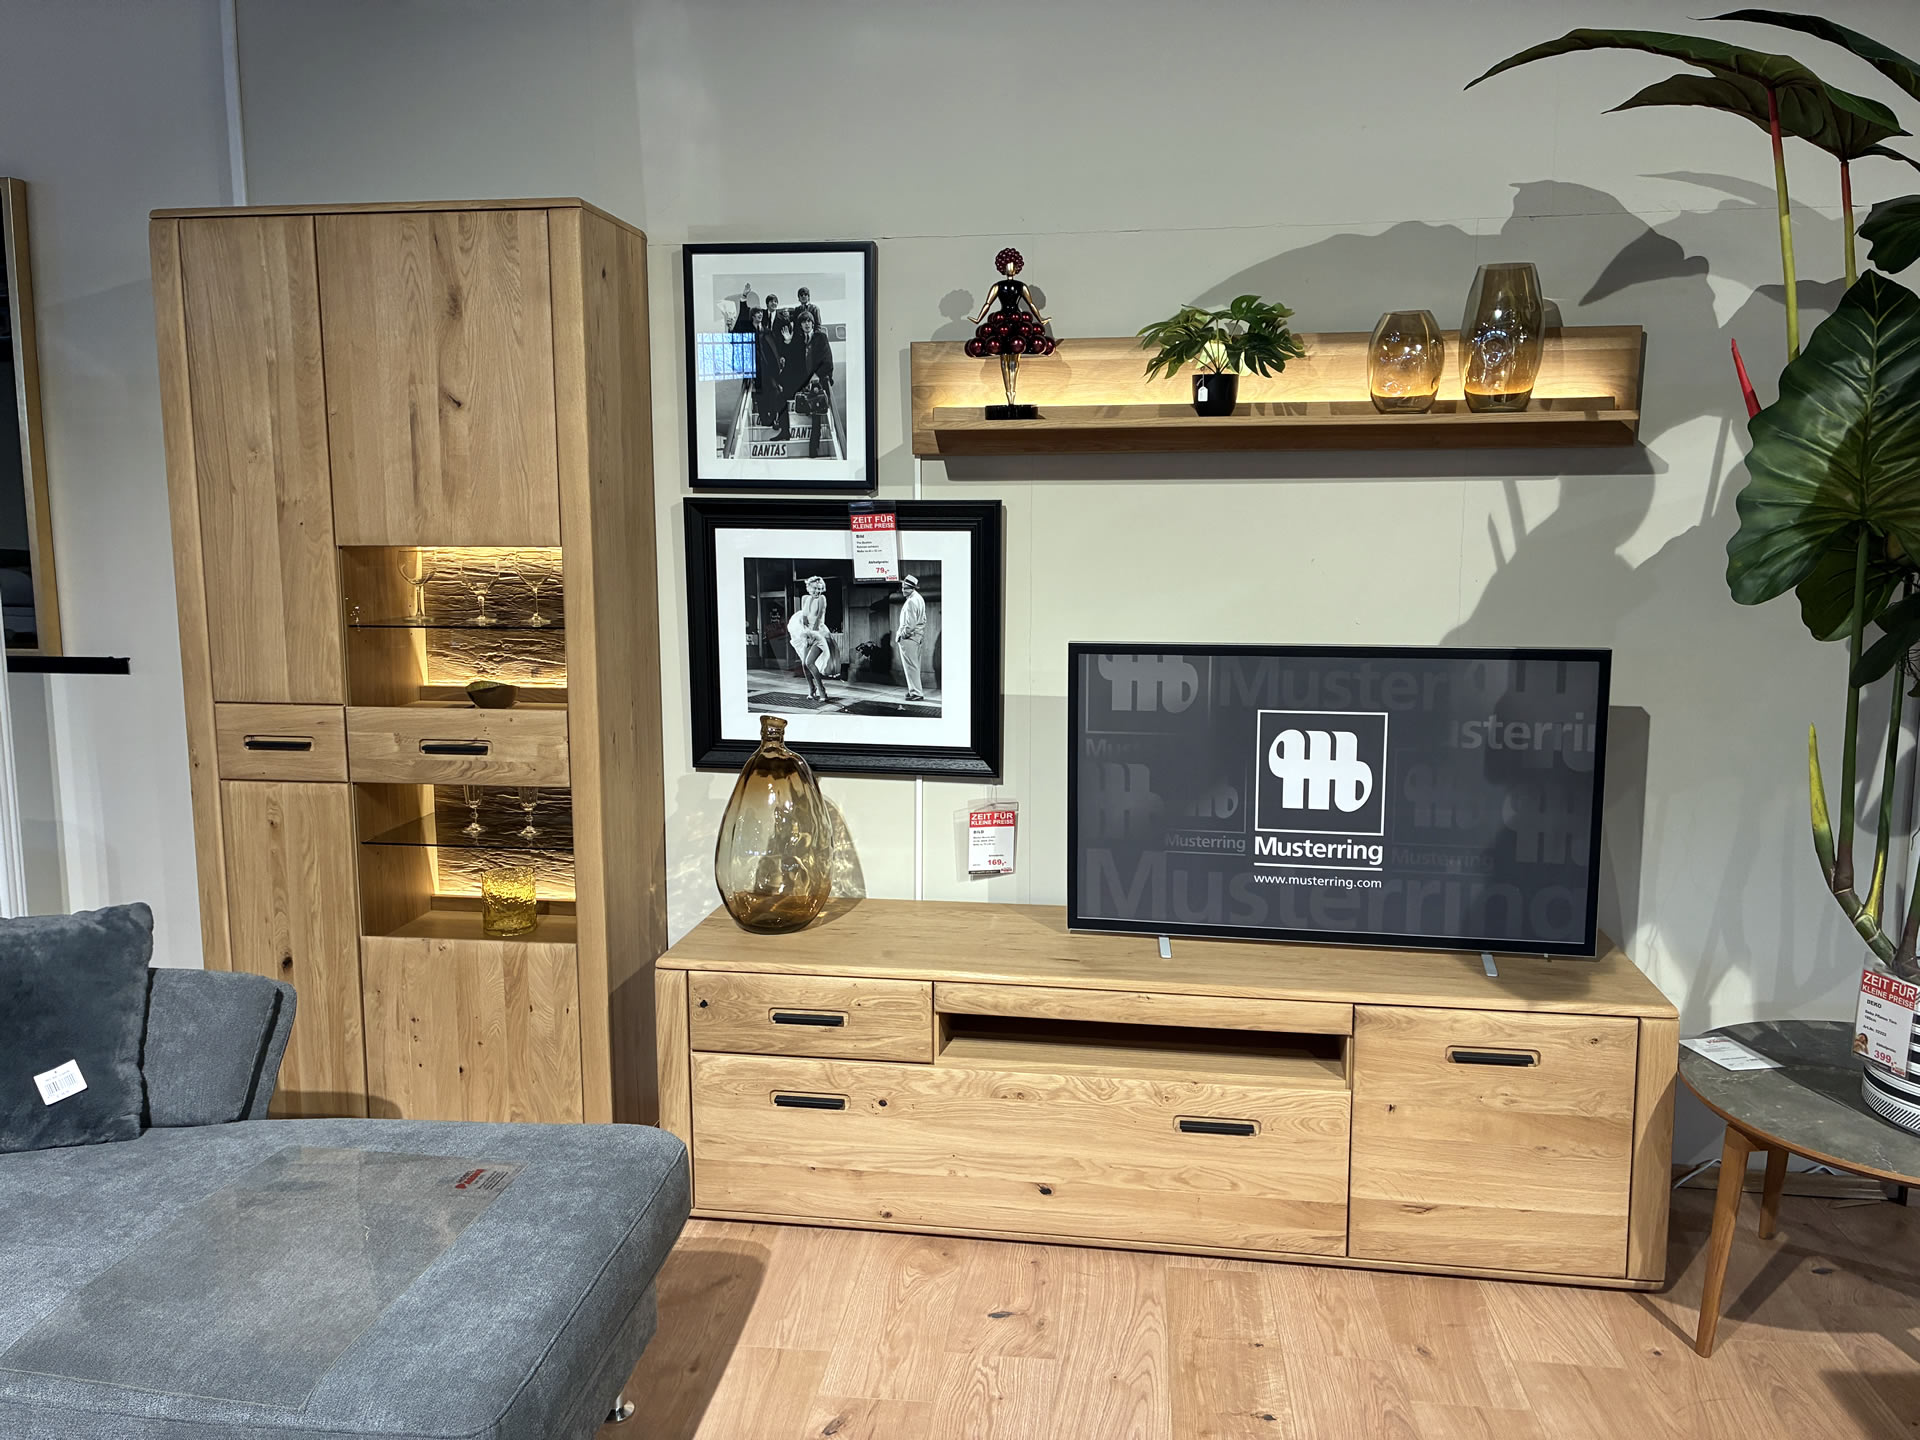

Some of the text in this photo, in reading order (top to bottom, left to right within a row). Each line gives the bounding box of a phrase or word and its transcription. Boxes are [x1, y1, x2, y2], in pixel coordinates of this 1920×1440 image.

[790, 427, 812, 438] QANT
[752, 444, 786, 456] QANTAS
[875, 514, 893, 523] FÜR
[971, 813, 992, 821] ZEIT
[1165, 834, 1246, 853] Musterring
[1254, 836, 1383, 865] Musterring
[1254, 875, 1382, 889] www.musterring.com
[1864, 972, 1915, 1000] ZEIT FÜR
[1862, 984, 1914, 1009] KLEINE PREISE
